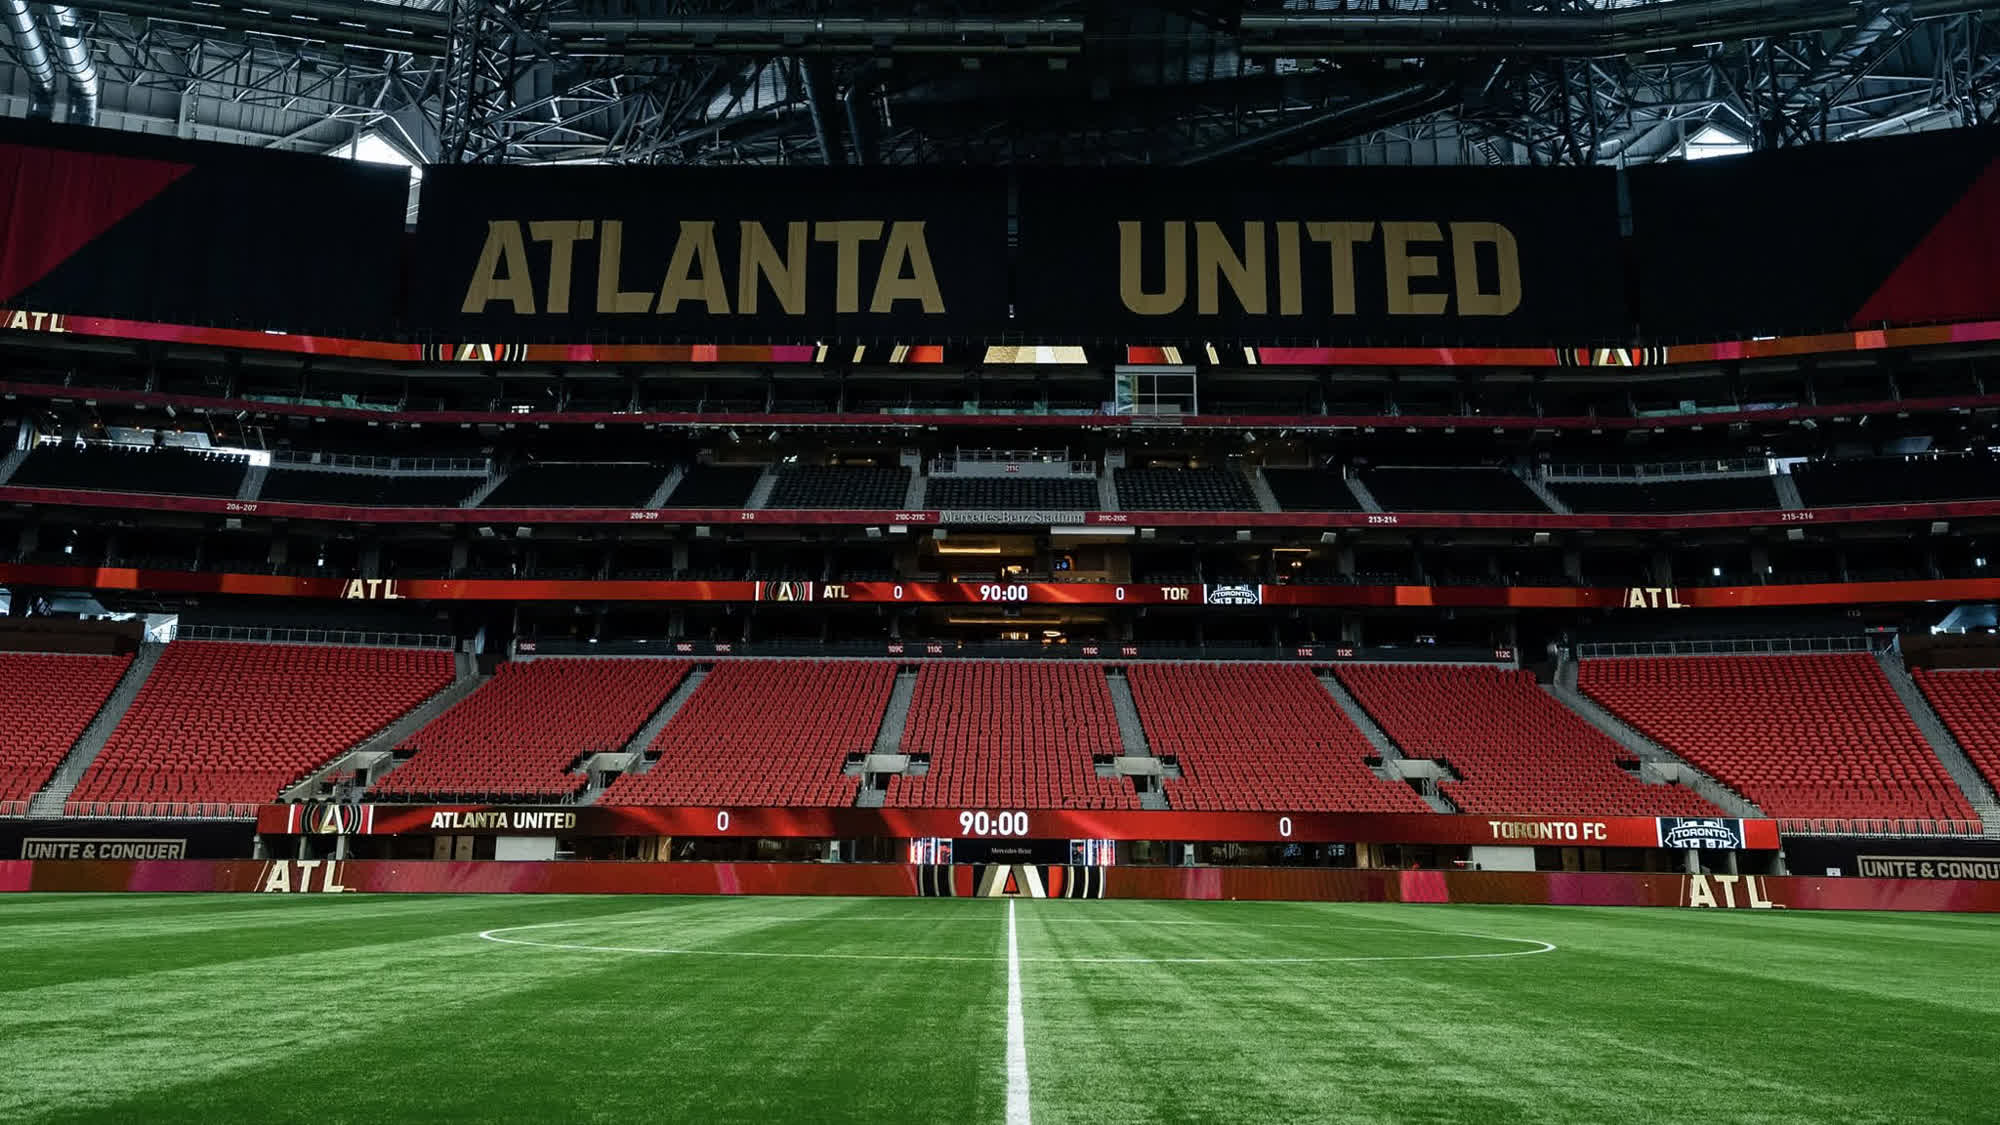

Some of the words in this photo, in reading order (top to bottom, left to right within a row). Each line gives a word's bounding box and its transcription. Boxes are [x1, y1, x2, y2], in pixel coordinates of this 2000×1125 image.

[461, 219, 946, 315] ATLANTA
[1117, 220, 1522, 316] UNITED
[10, 310, 66, 333] ATL
[741, 512, 755, 520] 210
[941, 511, 1031, 523] Mercedes-Benz
[1033, 511, 1085, 523] Stadium
[347, 578, 399, 600] ATL
[823, 585, 849, 599] ATL
[893, 585, 903, 600] 0
[980, 585, 1028, 601] 90:00
[1115, 587, 1125, 601] 0
[1161, 587, 1189, 600] TOR
[1215, 590, 1250, 598] TORONTO
[1629, 587, 1682, 608] ATL
[431, 812, 508, 829] ATLANTA
[513, 812, 577, 829] UNITED
[717, 811, 729, 831] 0
[959, 811, 1029, 836] 90:00
[1279, 817, 1291, 837] 0
[1488, 821, 1578, 840] TORONTO
[1582, 822, 1607, 840] FC
[1675, 827, 1728, 839] TORONTO
[28, 843, 79, 859] UNITE
[82, 843, 96, 859] &
[99, 843, 180, 860] CONQUER
[991, 847, 1032, 855] Mercedes-Benz
[264, 859, 345, 893] ATL
[1863, 860, 1917, 877] UNITE
[1920, 862, 1935, 878] &
[1690, 874, 1774, 908] ATL
